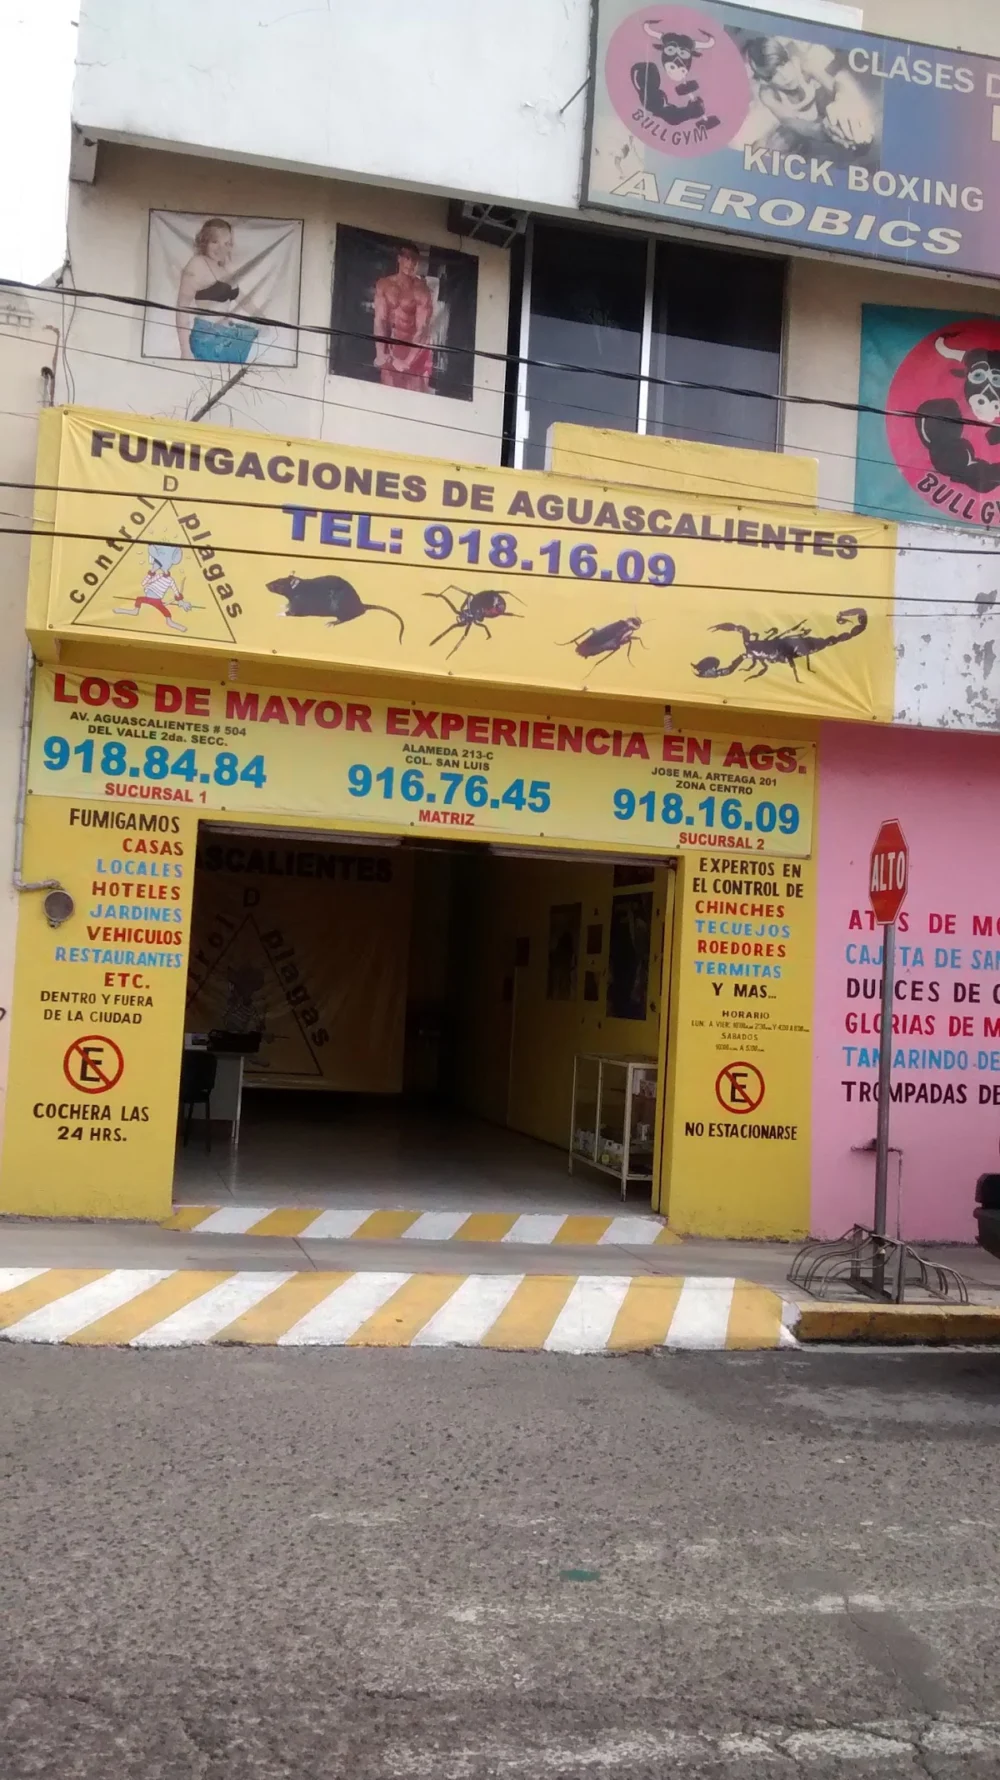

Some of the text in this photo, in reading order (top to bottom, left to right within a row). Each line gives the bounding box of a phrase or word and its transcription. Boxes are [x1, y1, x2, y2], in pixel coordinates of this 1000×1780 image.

[847, 47, 975, 94] CLASES
[743, 143, 984, 211] KICK BOXING
[610, 171, 962, 254] AEROBICS
[162, 475, 179, 492] D
[90, 429, 858, 560] FUMIGACIONES DE AGUASCALIENTES
[70, 494, 155, 605] control
[282, 504, 676, 587] TEL: 918.16.09
[178, 512, 243, 619] plagas
[53, 672, 807, 774] LOS DE MAYOR EXPERIENCIA EN AGS.
[69, 711, 247, 737] AV. AGUASCALIENTES # 504
[88, 724, 228, 747] DEL VALLE 2da. SECC.
[43, 735, 267, 789] 918.84.84
[402, 744, 494, 760] ALAMEDA 213-C
[405, 755, 490, 771] COL. SAN LUIS
[651, 766, 777, 787] JOSE MA. ARTEAGA 201
[105, 782, 207, 804] SUCURSAL 1
[348, 764, 550, 813] 916.76.45
[675, 780, 753, 795] ZONA CENTRO
[70, 808, 180, 833] FUMIGAMOS
[419, 809, 475, 826] MATRIZ
[612, 788, 800, 834] 918.16.09
[122, 838, 183, 856] CASAS
[679, 832, 765, 851] SUCURSAL 2
[96, 859, 182, 878] LOCALES
[699, 858, 801, 878] EXPERTOS EN
[871, 851, 905, 892] ALTO
[92, 881, 180, 900] HOTELES
[693, 878, 803, 898] EL CONTROL DE
[90, 904, 182, 922] JARDINES
[695, 900, 785, 918] CHINCHES
[695, 920, 790, 938] TECUEJOS
[849, 910, 909, 932] ATS
[929, 913, 957, 935] DE
[87, 925, 182, 945] VEHICULOS
[55, 947, 183, 968] RESTAURANTES
[697, 939, 786, 958] ROEDORES
[846, 943, 925, 967] CAJTA
[935, 947, 962, 969] DE
[694, 961, 781, 979] TERMITAS
[104, 972, 150, 989] ETC.
[712, 982, 723, 996] Y
[40, 990, 153, 1007] DENTRO Y FUERA
[954, 982, 981, 1004] DE
[44, 1009, 142, 1024] DE LA CIUDAD
[722, 1010, 770, 1020] HORARIO
[721, 1032, 758, 1041] SABADOS
[949, 1016, 974, 1037] DE
[977, 1051, 1000, 1071] DE
[33, 1103, 149, 1121] COCHERA LAS
[57, 1126, 127, 1141] 24 HRS.
[685, 1122, 798, 1141] NO ESTACIONARSE
